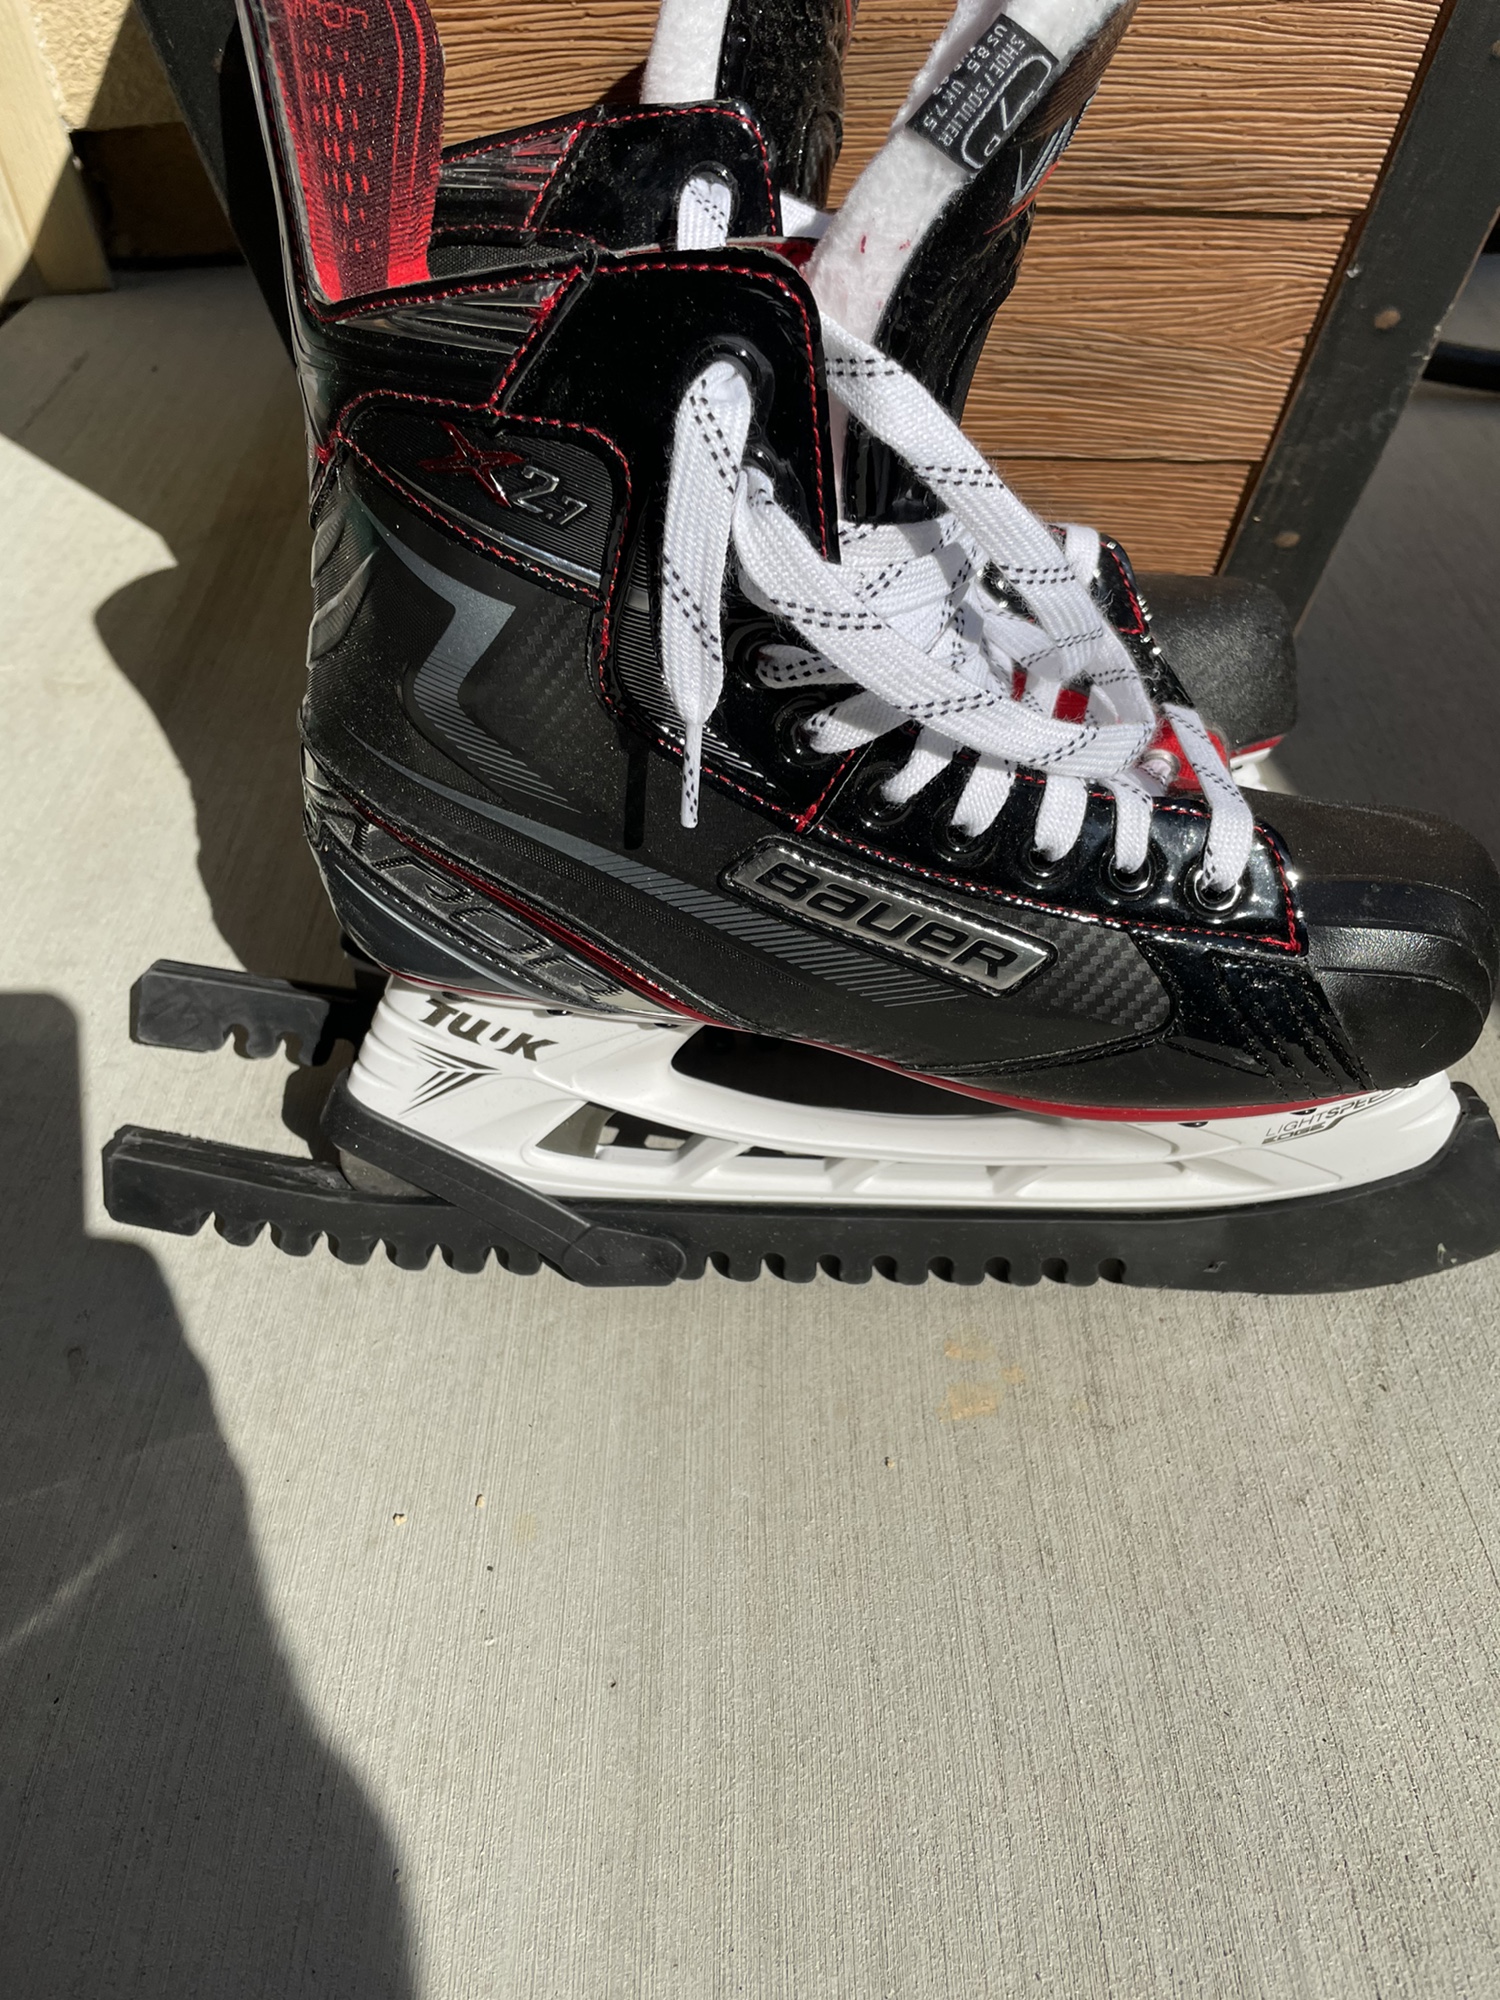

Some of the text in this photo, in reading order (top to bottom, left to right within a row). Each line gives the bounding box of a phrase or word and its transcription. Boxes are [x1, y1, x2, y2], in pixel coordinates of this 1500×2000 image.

[987, 24, 1008, 47] US
[967, 46, 990, 74] 8.5
[942, 80, 966, 105] UK
[923, 104, 948, 132] 7.5
